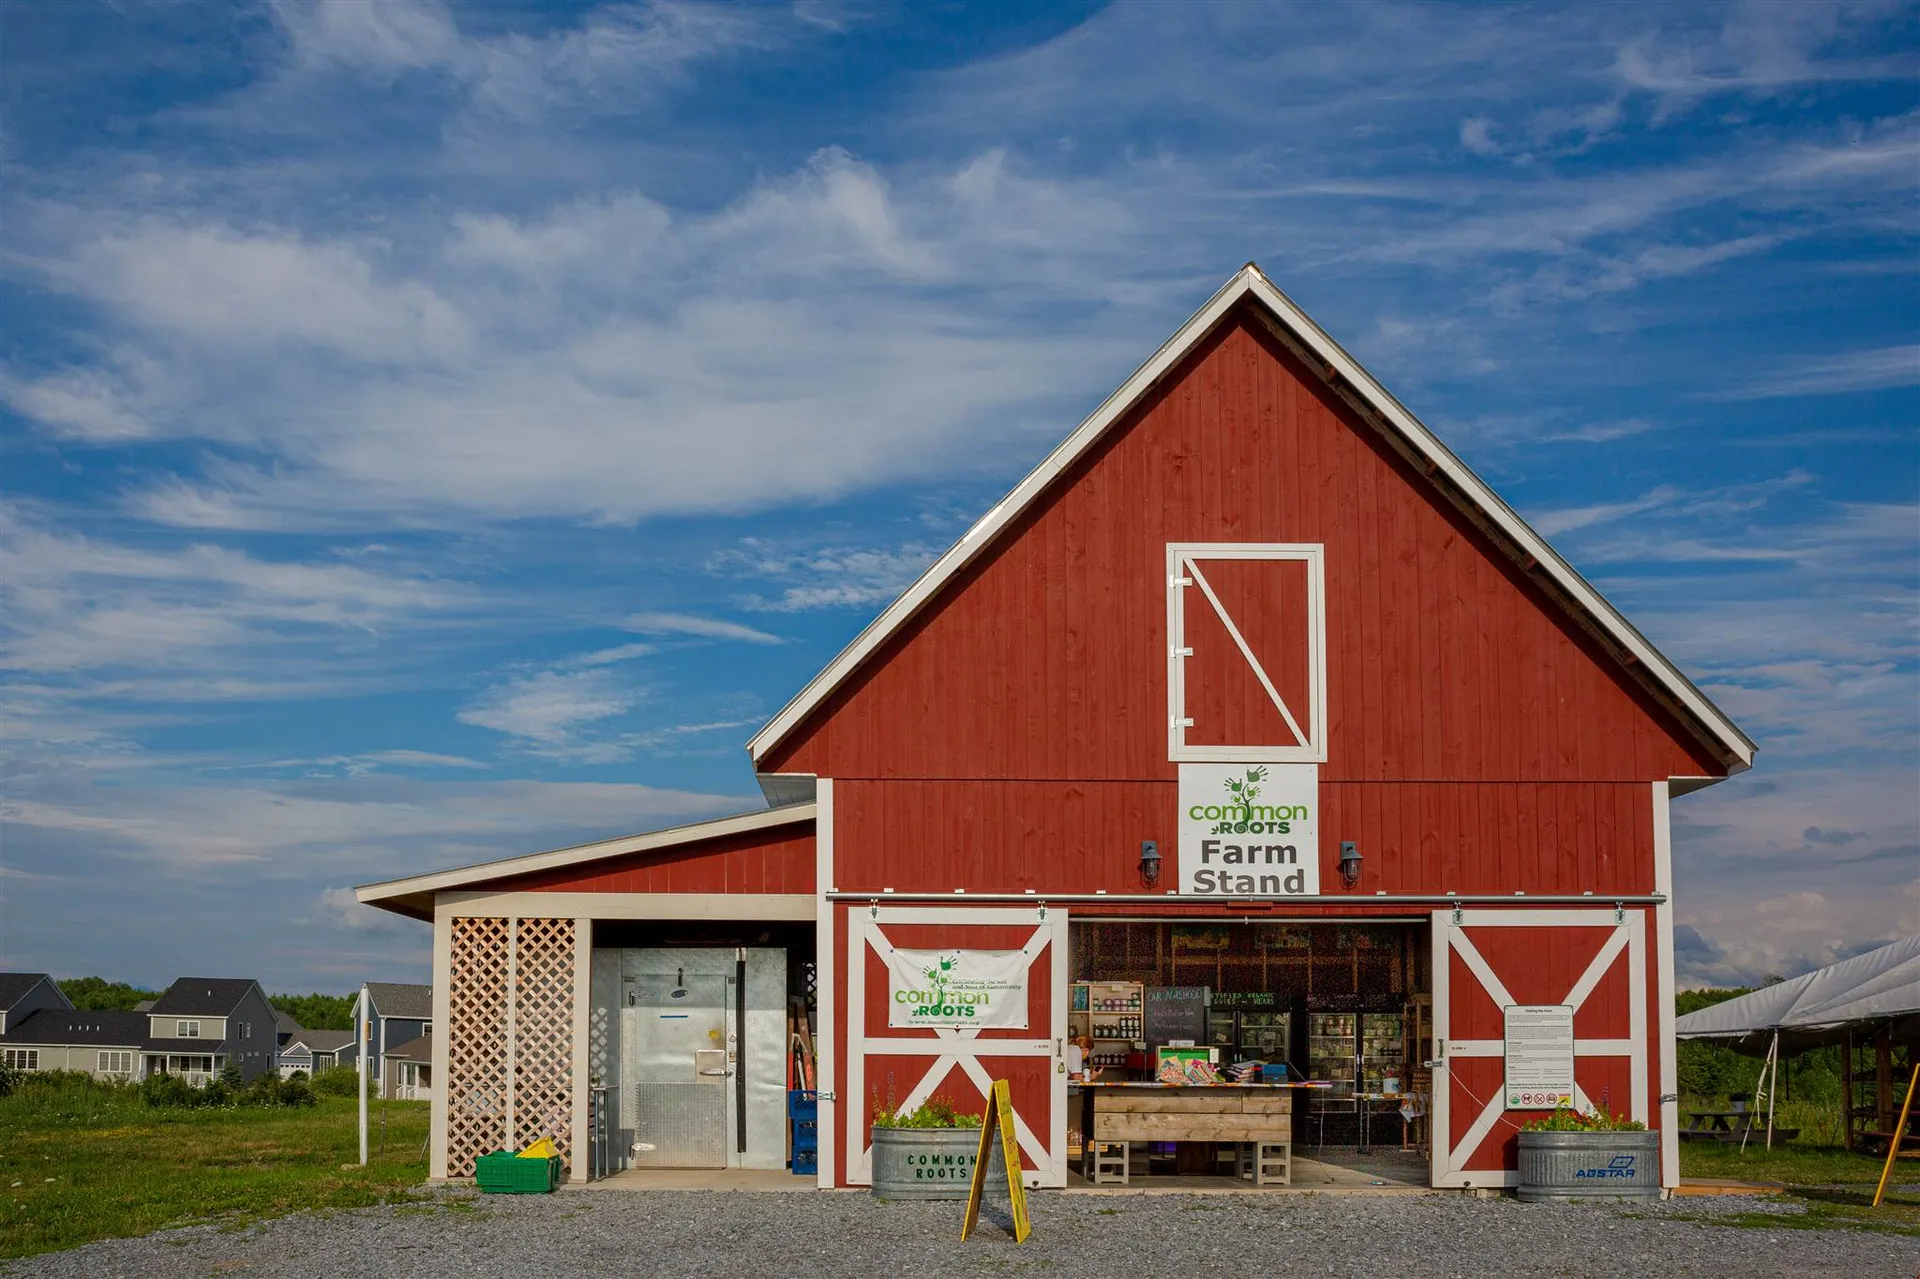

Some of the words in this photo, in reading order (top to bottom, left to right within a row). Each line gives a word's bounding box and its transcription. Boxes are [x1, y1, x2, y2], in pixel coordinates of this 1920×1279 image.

[1189, 805, 1308, 821] common
[1219, 822, 1291, 834] ROOTS
[1201, 840, 1297, 864] Farm
[1193, 869, 1305, 894] Stand
[895, 990, 989, 1005] common
[919, 1005, 975, 1017] ROOTS
[907, 1154, 977, 1166] COMMON
[916, 1168, 967, 1179] ROOTS
[1576, 1169, 1636, 1178] AGSTAR
